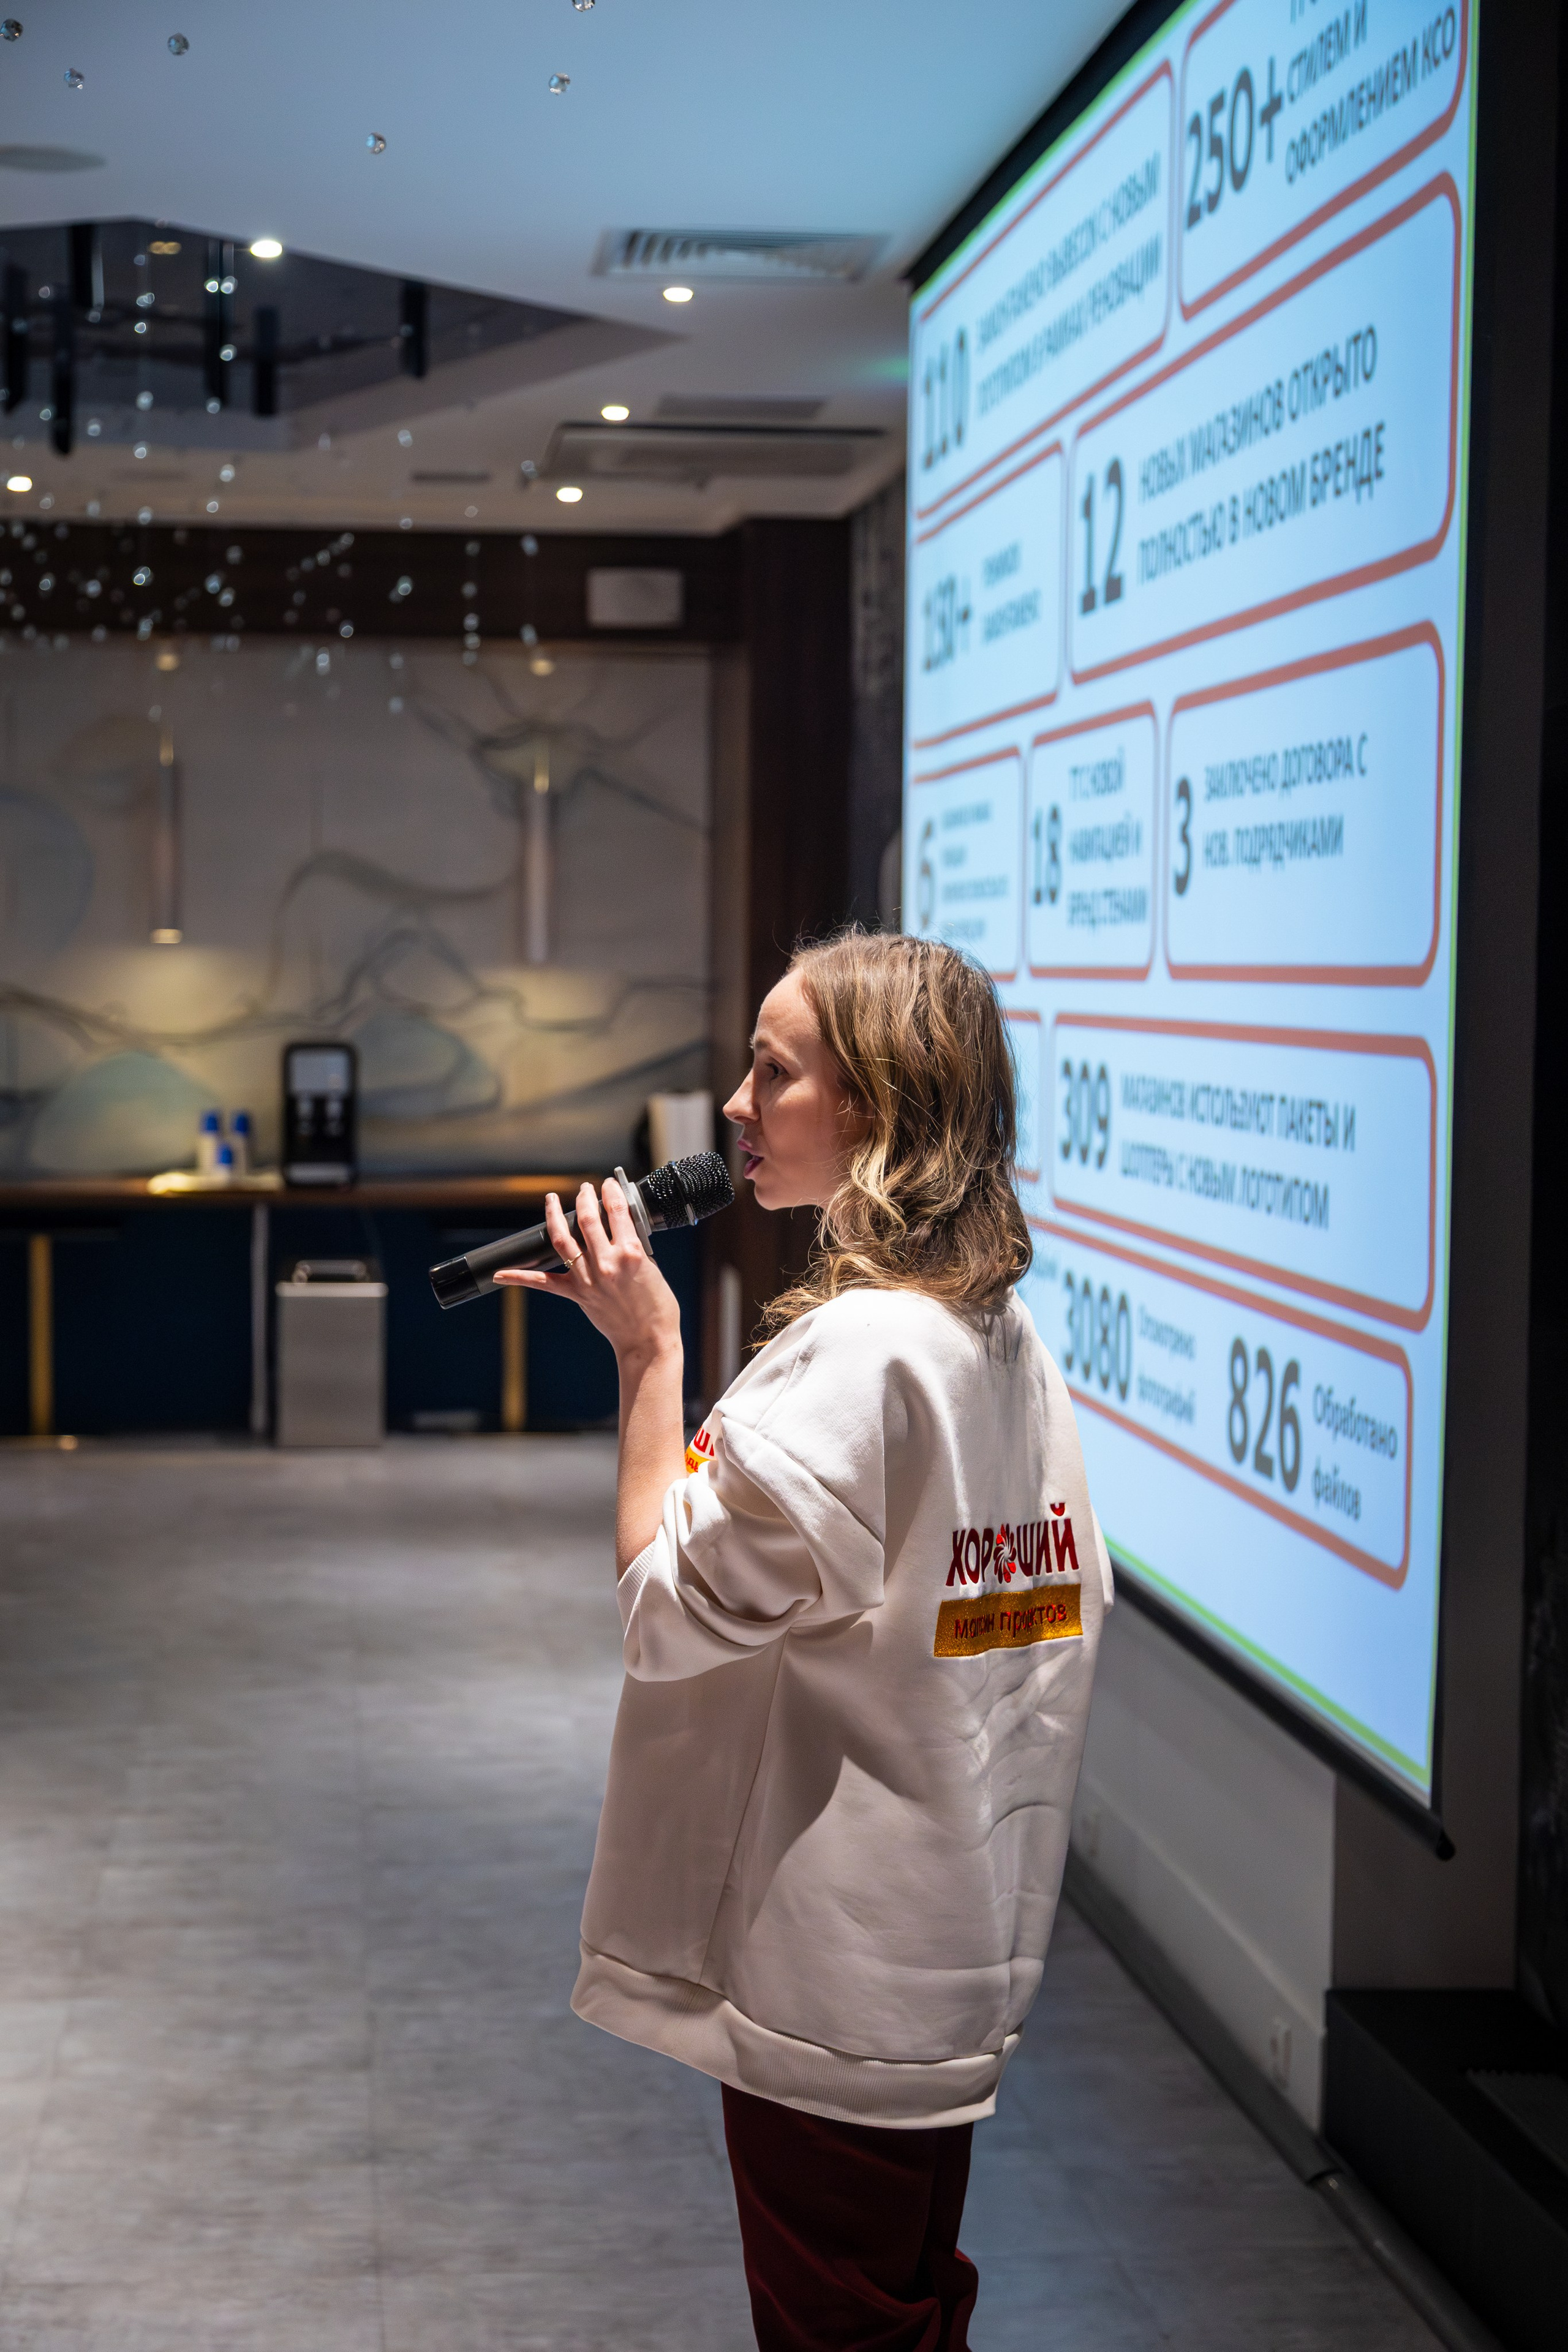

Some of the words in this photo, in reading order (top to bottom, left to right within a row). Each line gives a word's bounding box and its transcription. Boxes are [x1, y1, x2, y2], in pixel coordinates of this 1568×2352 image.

[1354, 0, 1367, 49] И
[1186, 56, 1283, 231] 250+
[1286, 37, 1418, 184] ОФОРМЛЕНИЕМ
[1422, 6, 1456, 80] КСО
[1188, 378, 1284, 478] МАГАЗИНОВ
[1287, 323, 1377, 423] ОТКРЫТО
[1080, 455, 1124, 617] 12
[1137, 501, 1224, 586] ПОЛНОСТЬЮ
[1228, 494, 1239, 545] В
[1242, 459, 1305, 540] НОВОМ
[1309, 420, 1385, 508] БРЕНДЕ
[1204, 750, 1278, 804] ЗАКЛЮЧЕНО
[1279, 735, 1354, 800] ДОГОВОРА
[1357, 732, 1368, 778] С
[1033, 804, 1063, 906] 18
[1174, 775, 1193, 897] 3
[1232, 813, 1344, 874] ПОДРЯДЧИКАМИ
[1060, 1058, 1112, 1171] 309
[1276, 1092, 1340, 1150] ПАКЕТЫ
[1343, 1102, 1356, 1153] И
[1188, 1153, 1237, 1205] НОВЫМ
[1238, 1164, 1330, 1231] ЛОГОТИПОМ
[1063, 1269, 1132, 1403] 3080
[1227, 1336, 1302, 1493] 826
[1313, 1383, 1398, 1460] Обработано
[1311, 1456, 1362, 1521] файлов
